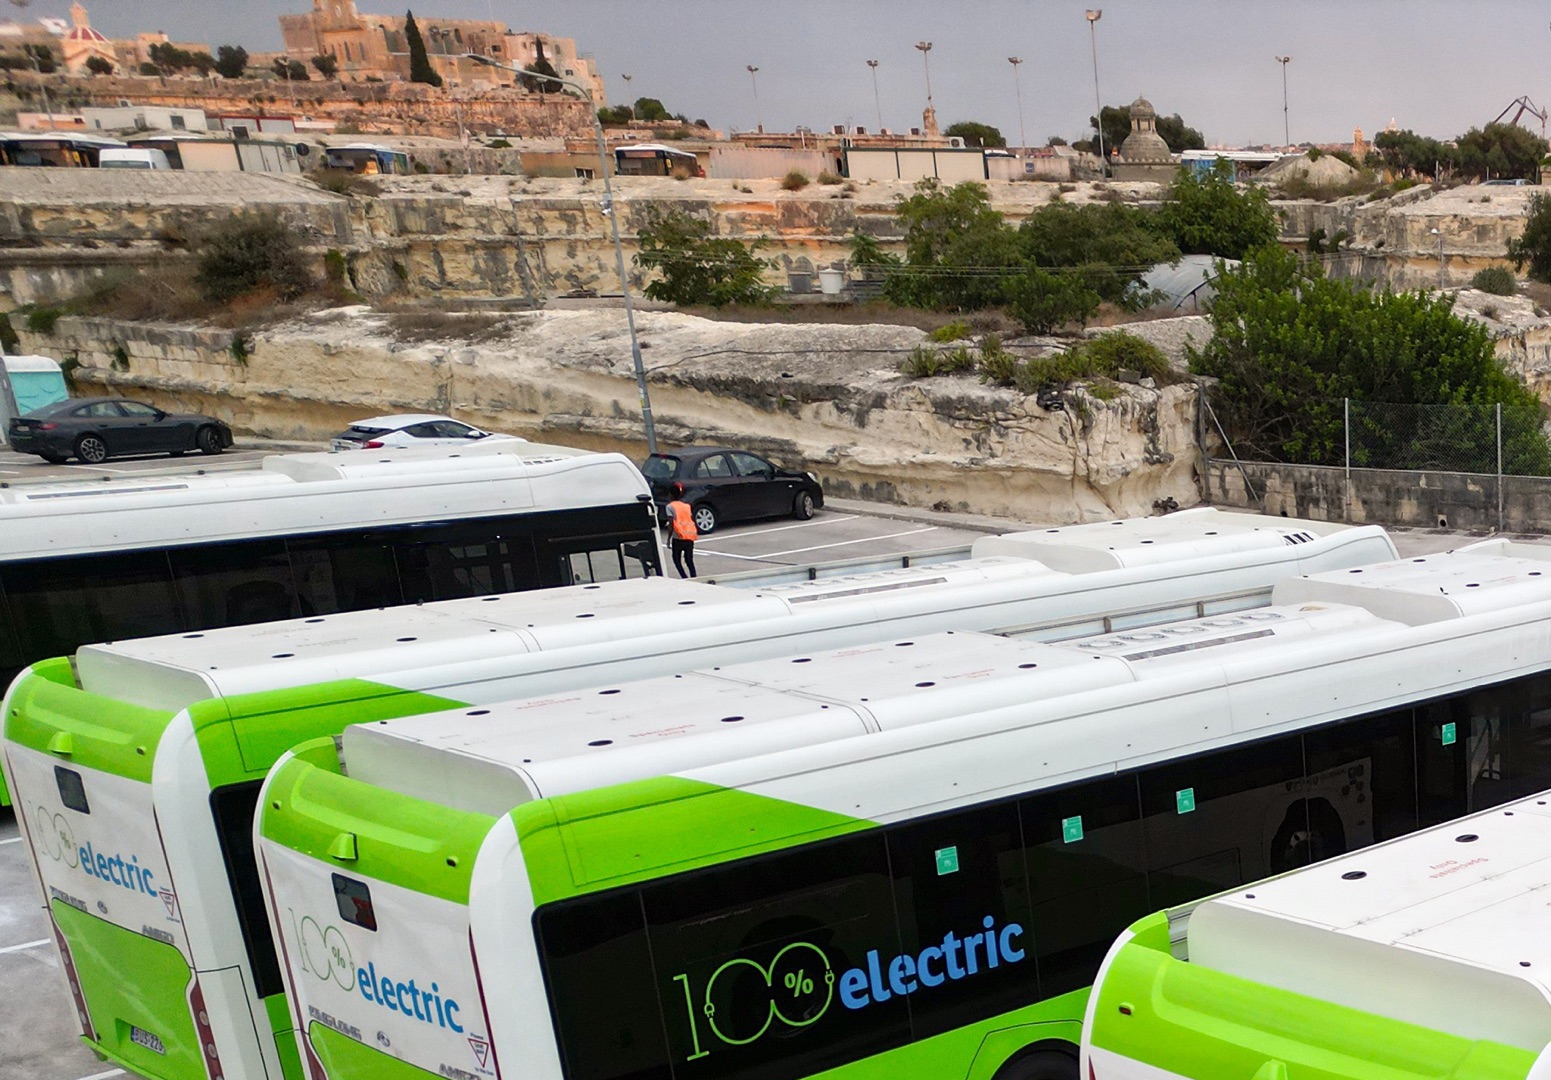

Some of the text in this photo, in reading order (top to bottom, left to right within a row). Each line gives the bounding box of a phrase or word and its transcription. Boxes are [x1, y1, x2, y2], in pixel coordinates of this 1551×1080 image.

[79, 840, 158, 898] electric
[357, 961, 464, 1034] electric
[838, 915, 1026, 1011] electric
